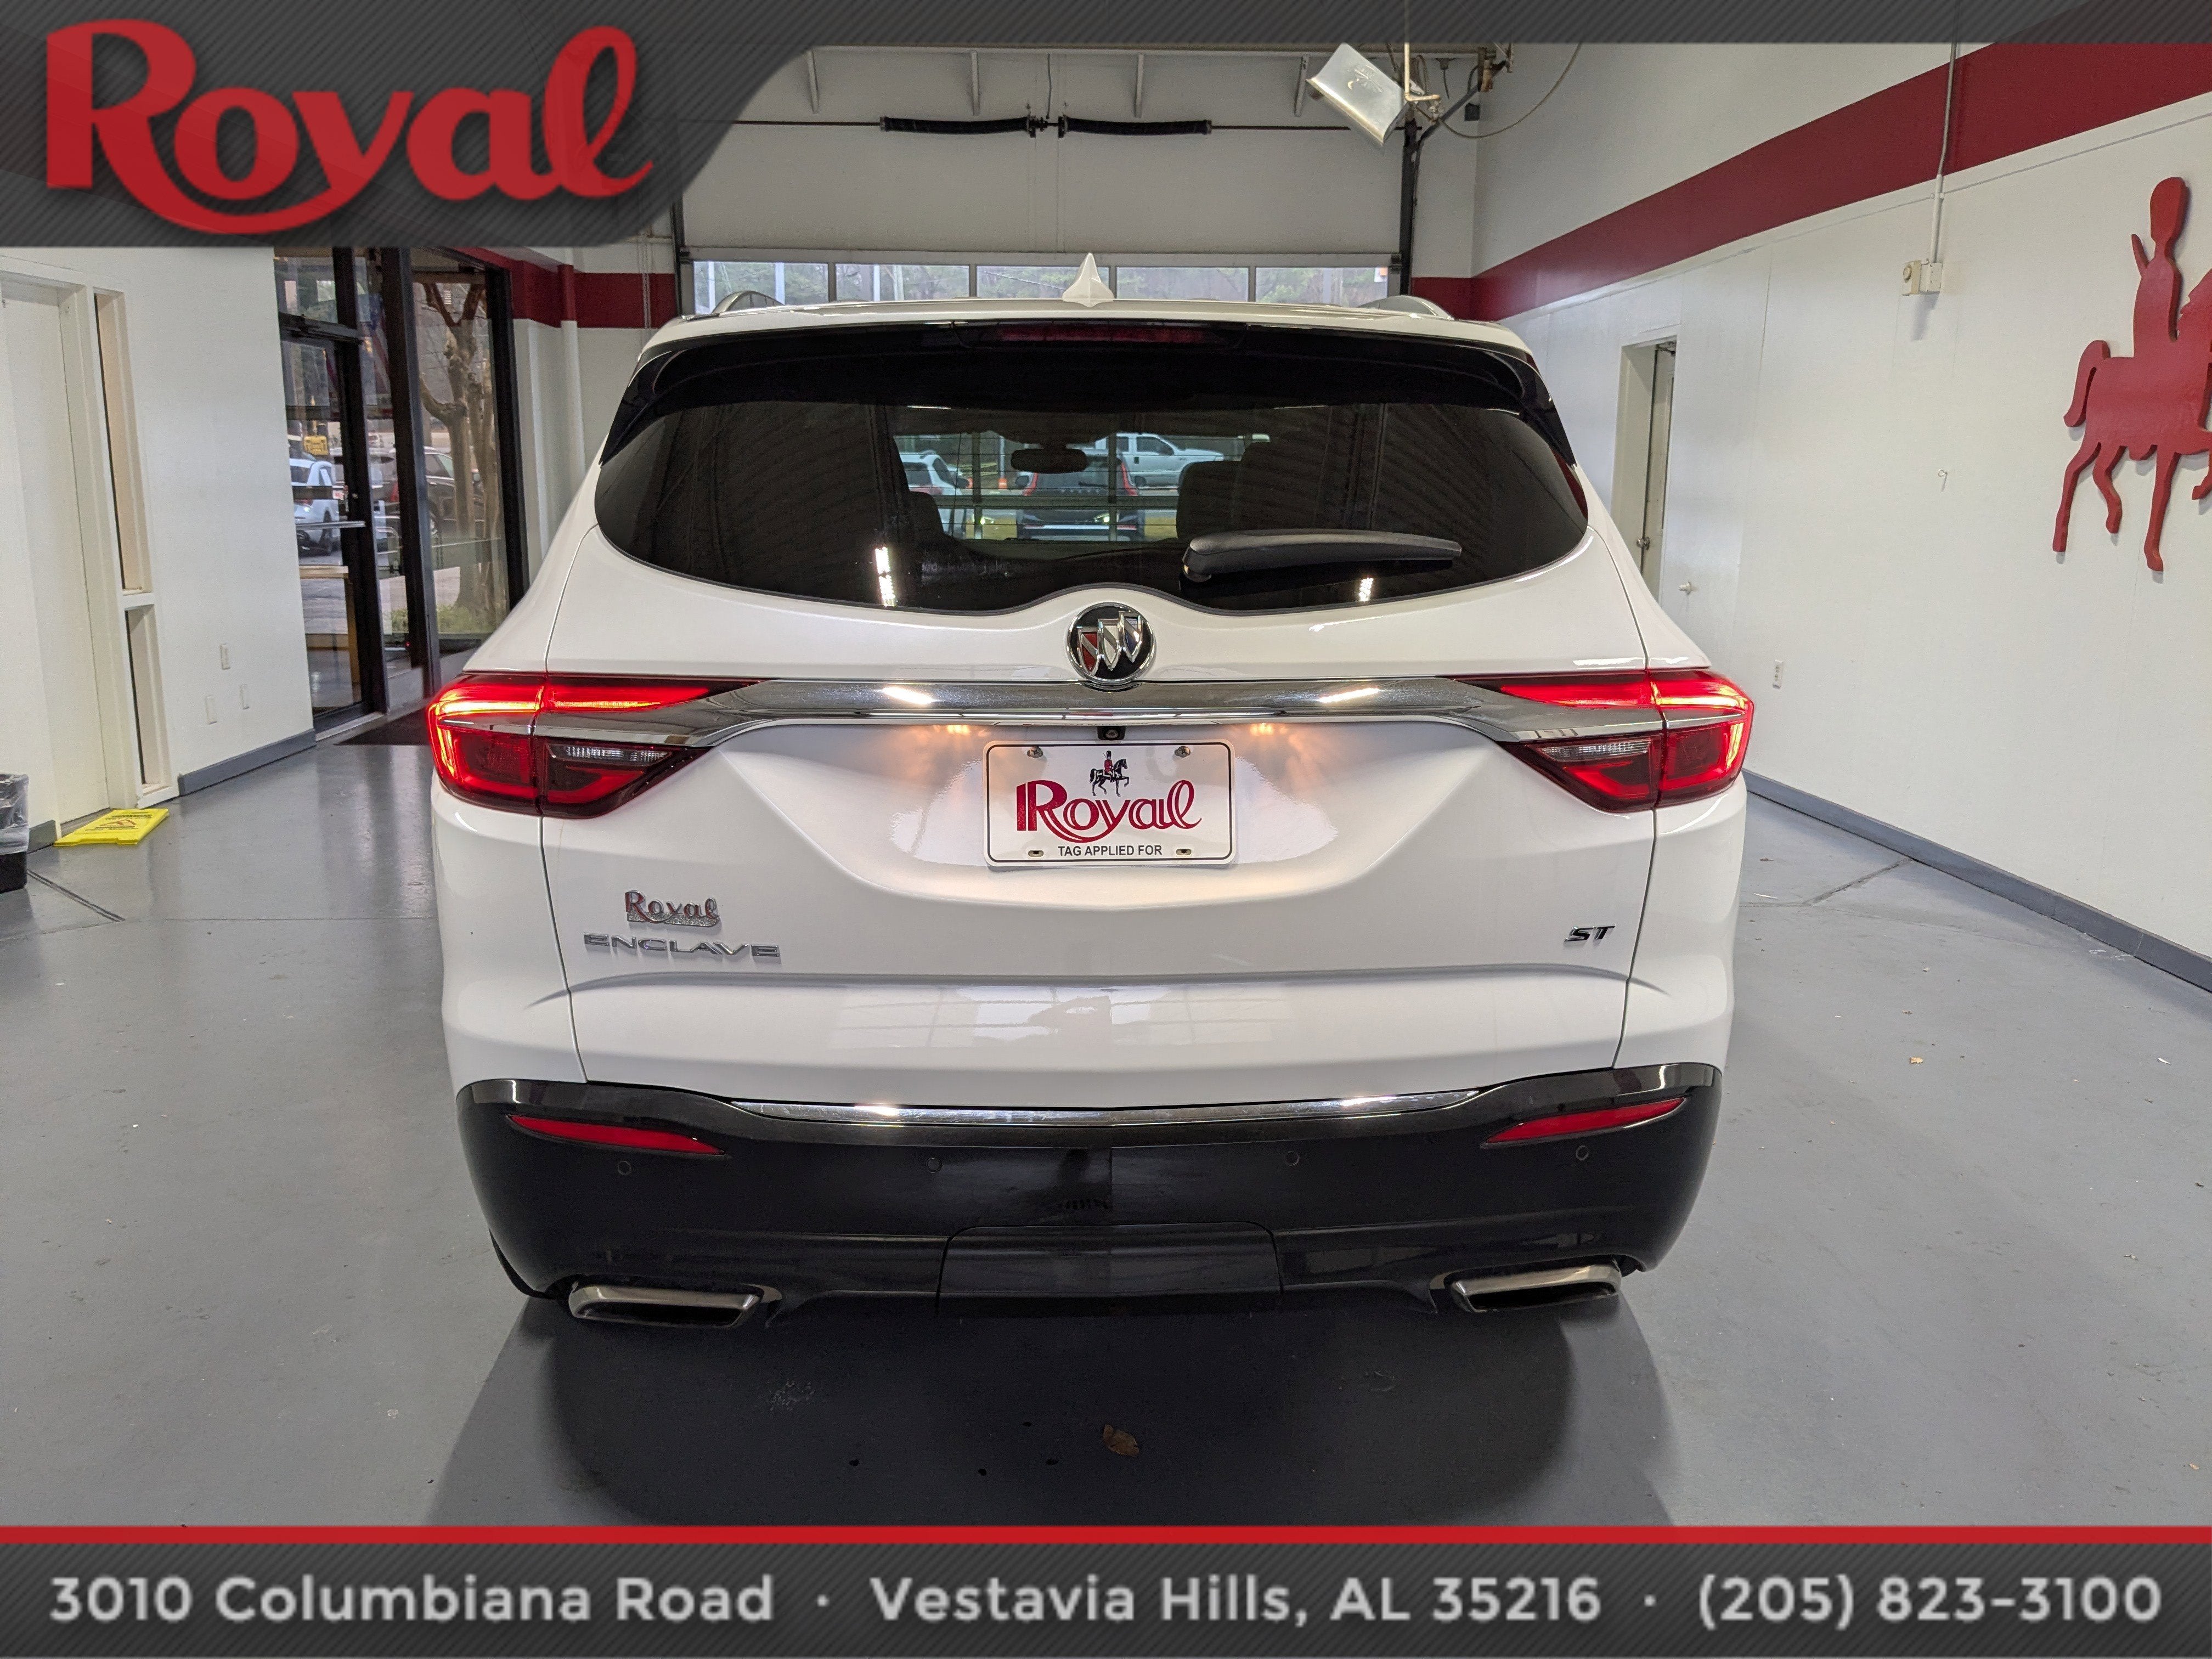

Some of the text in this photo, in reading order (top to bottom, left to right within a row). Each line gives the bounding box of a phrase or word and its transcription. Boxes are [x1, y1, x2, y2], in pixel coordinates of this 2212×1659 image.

[1017, 780, 1202, 843] Royal
[1058, 845, 1163, 856] TAG APPLIED FOR
[625, 890, 719, 927] Royal
[584, 933, 780, 957] ENCLAVE
[1564, 925, 1616, 942] ST
